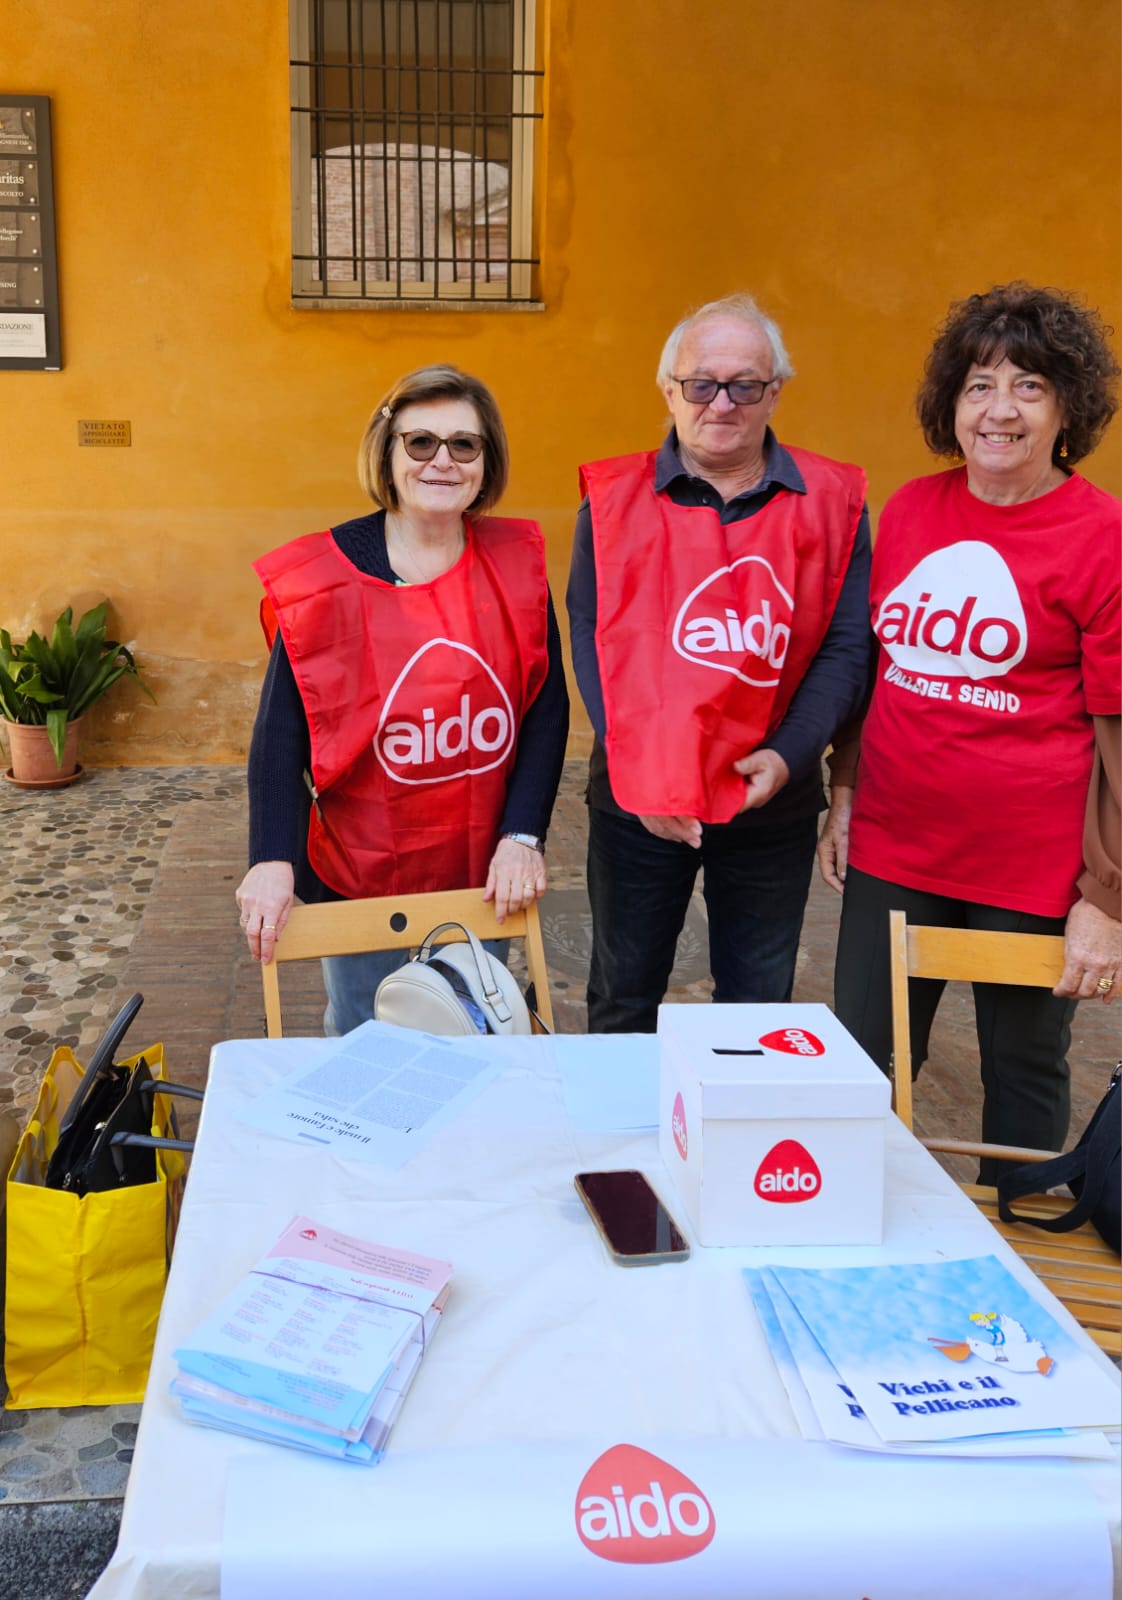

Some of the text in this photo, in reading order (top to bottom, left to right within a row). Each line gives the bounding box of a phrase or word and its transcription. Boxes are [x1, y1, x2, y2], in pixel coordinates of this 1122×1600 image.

[683, 599, 791, 670] aido
[877, 592, 1021, 664] aido
[917, 677, 952, 700] DEL
[958, 684, 1020, 713] SENIO
[383, 694, 508, 765] aido
[783, 1029, 818, 1055] aido
[759, 1167, 818, 1193] aido
[877, 1375, 1001, 1396] Vichi e il
[891, 1396, 1018, 1416] Pellicano
[580, 1481, 710, 1541] aido
